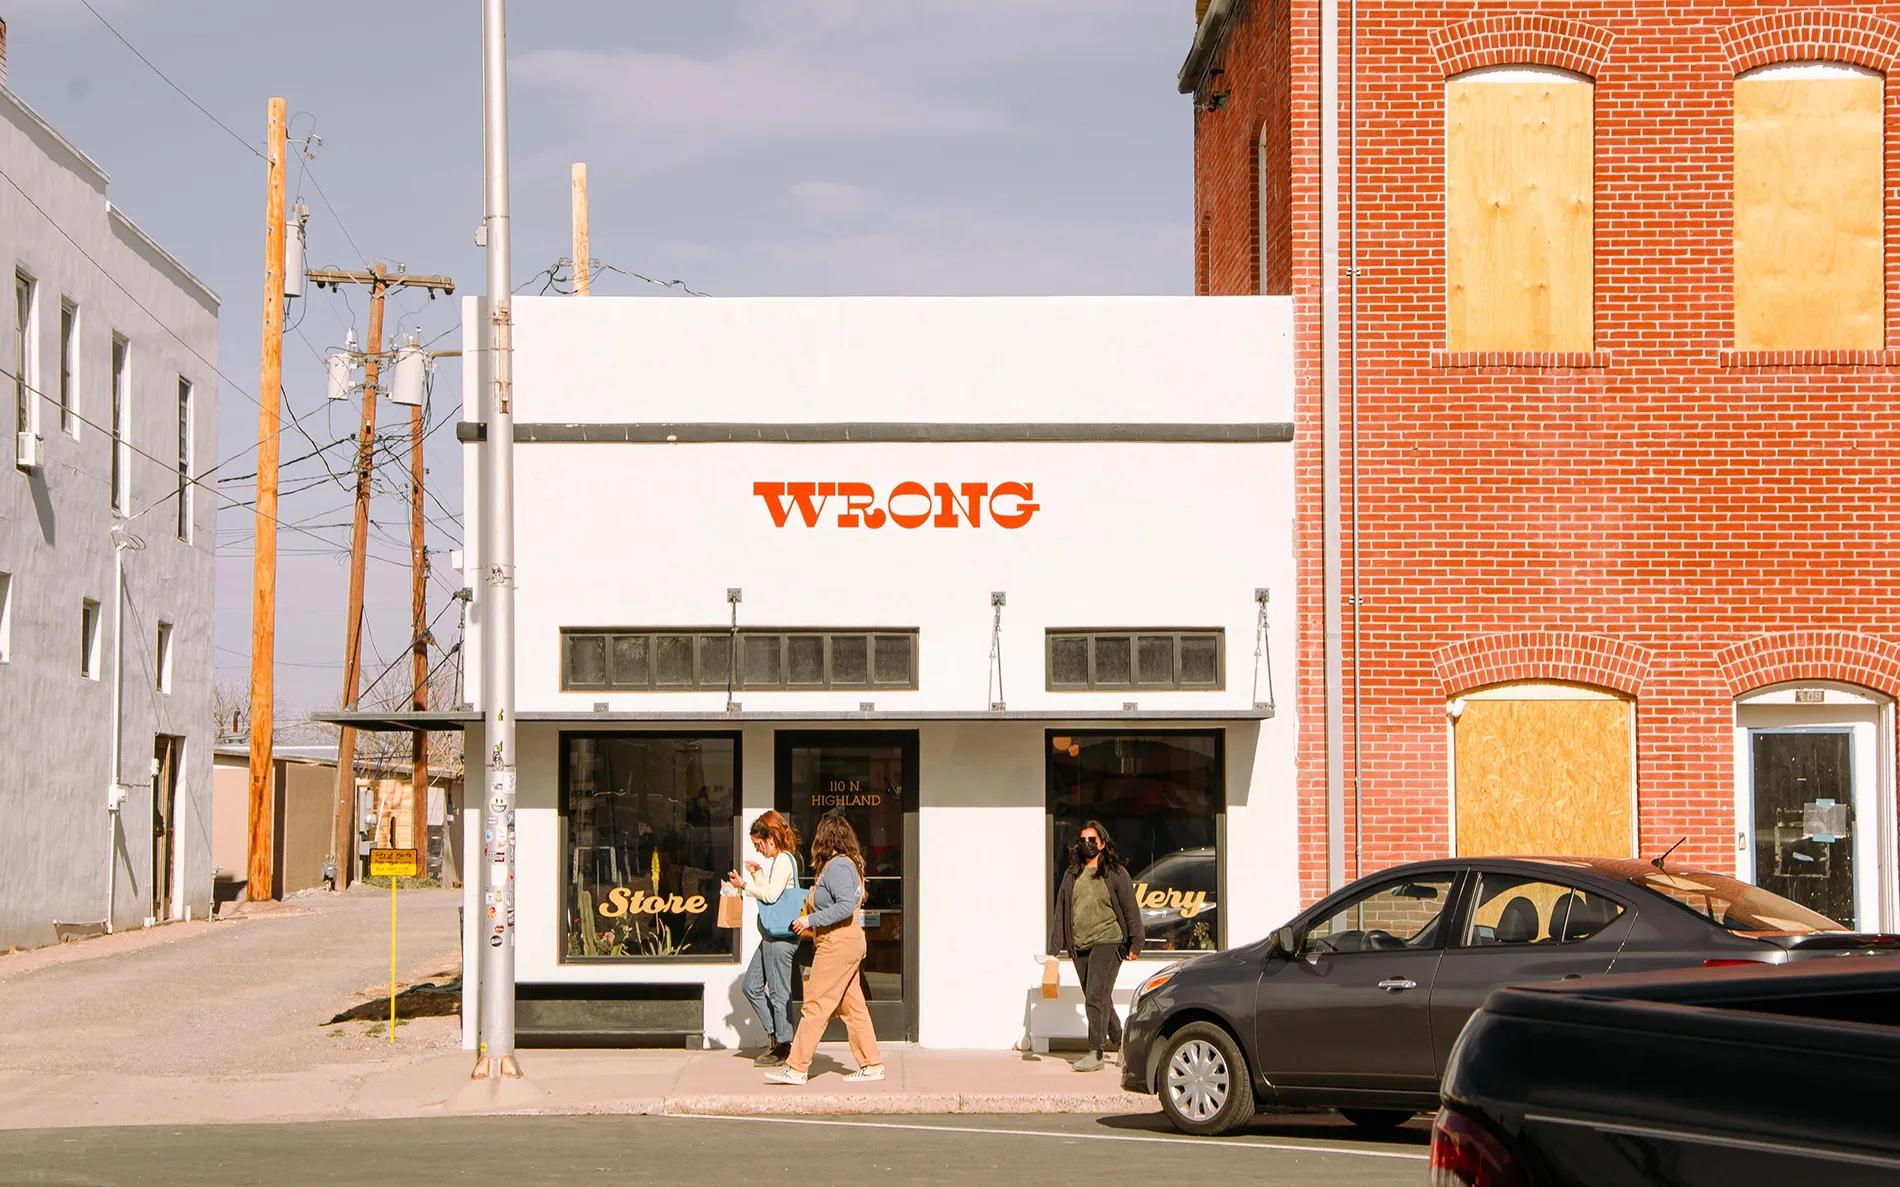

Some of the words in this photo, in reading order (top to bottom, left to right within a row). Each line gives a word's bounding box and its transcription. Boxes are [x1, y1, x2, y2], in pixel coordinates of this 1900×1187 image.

[753, 481, 1040, 529] WRONG
[811, 794, 882, 806] HIGHLAND
[830, 780, 846, 792] 110
[849, 780, 862, 792] N.
[598, 886, 708, 918] Store
[1133, 882, 1206, 918] lery
